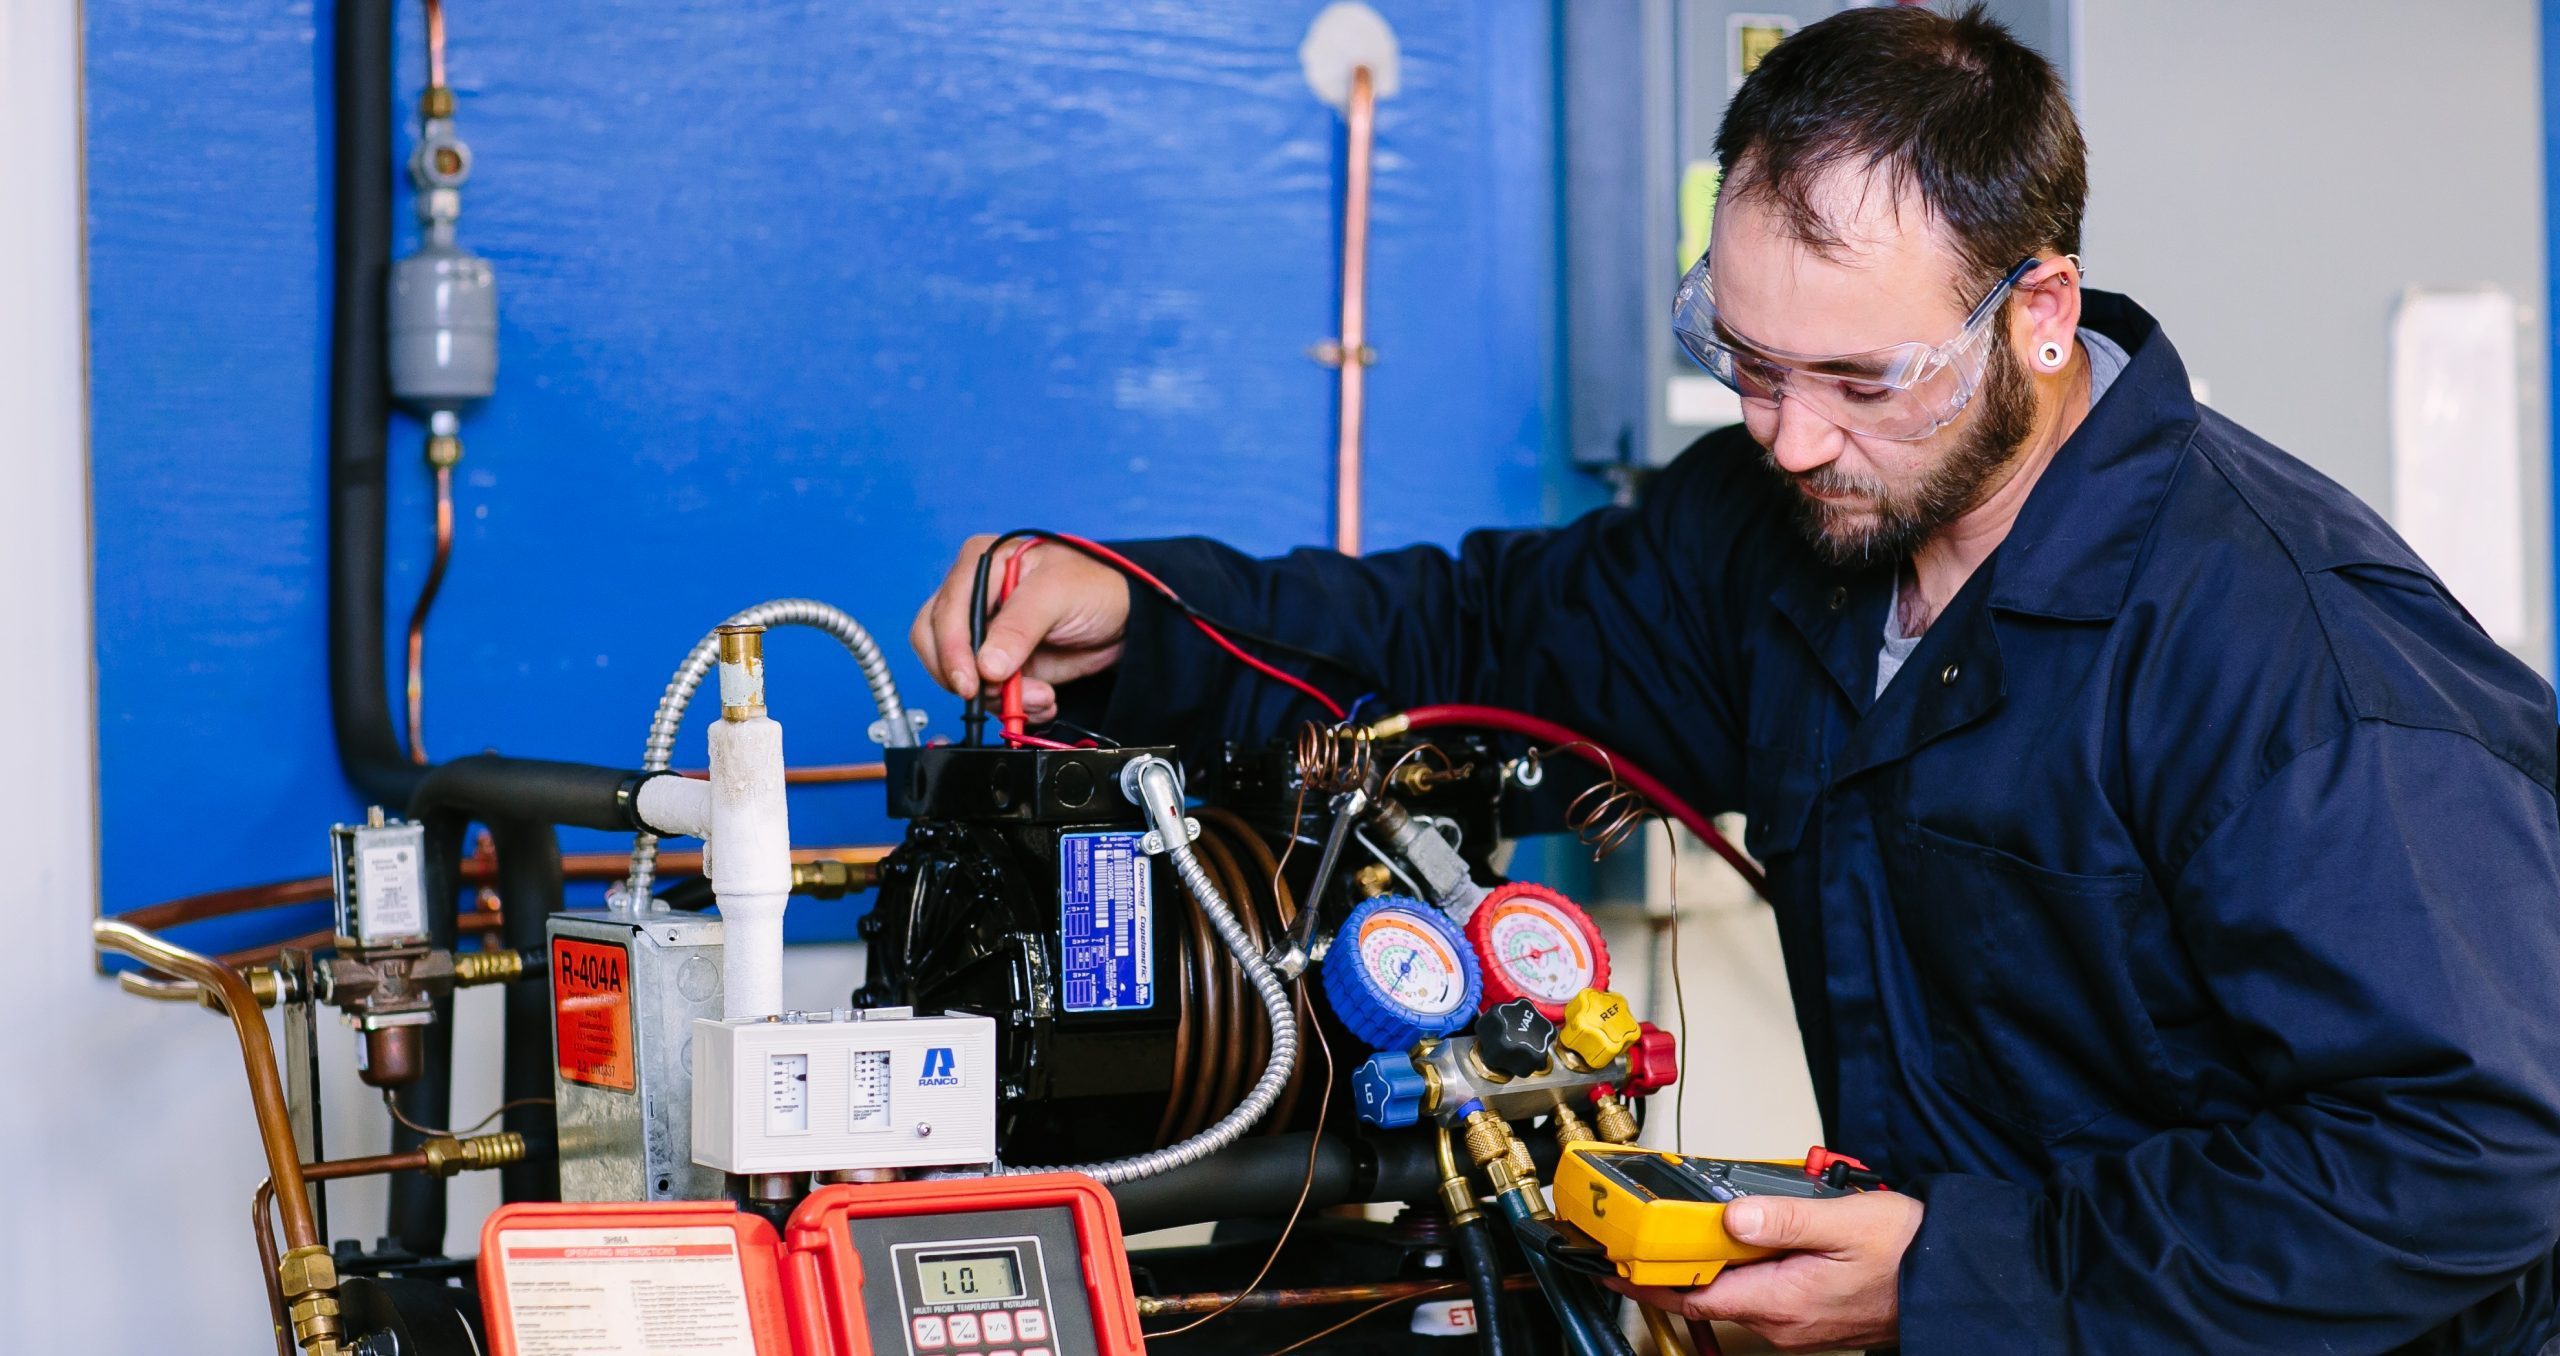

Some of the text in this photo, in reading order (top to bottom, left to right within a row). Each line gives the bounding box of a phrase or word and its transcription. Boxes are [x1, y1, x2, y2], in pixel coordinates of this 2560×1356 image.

[1138, 862, 1147, 908] Copeland
[1139, 915, 1148, 980] Copelametic
[561, 951, 622, 993] R-404A
[1518, 1009, 1534, 1032] VAC
[1600, 1002, 1620, 1022] REF
[918, 1077, 959, 1087] RANCO
[563, 1246, 678, 1258] OPERATING INSTRUCTIONS
[913, 1299, 1040, 1315] MULTI PROBE TEMPERATURE INSTRUMENT
